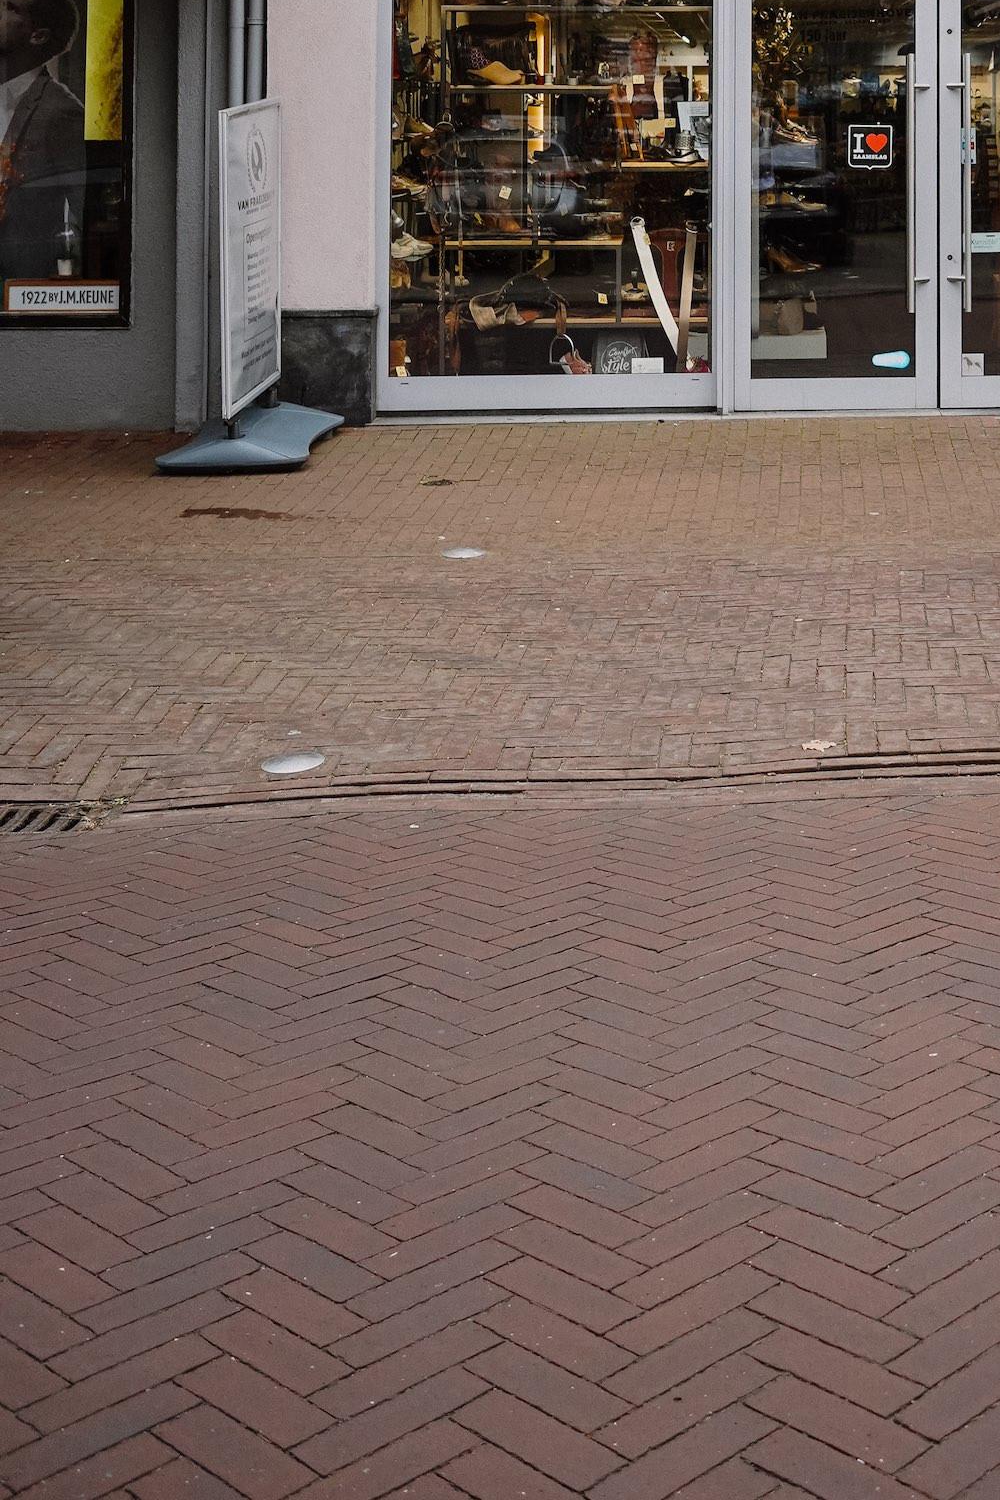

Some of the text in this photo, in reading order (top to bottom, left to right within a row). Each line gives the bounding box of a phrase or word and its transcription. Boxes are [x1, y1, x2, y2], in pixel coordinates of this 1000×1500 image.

[853, 133, 865, 153] I
[21, 290, 47, 305] 1922
[48, 292, 59, 303] BY
